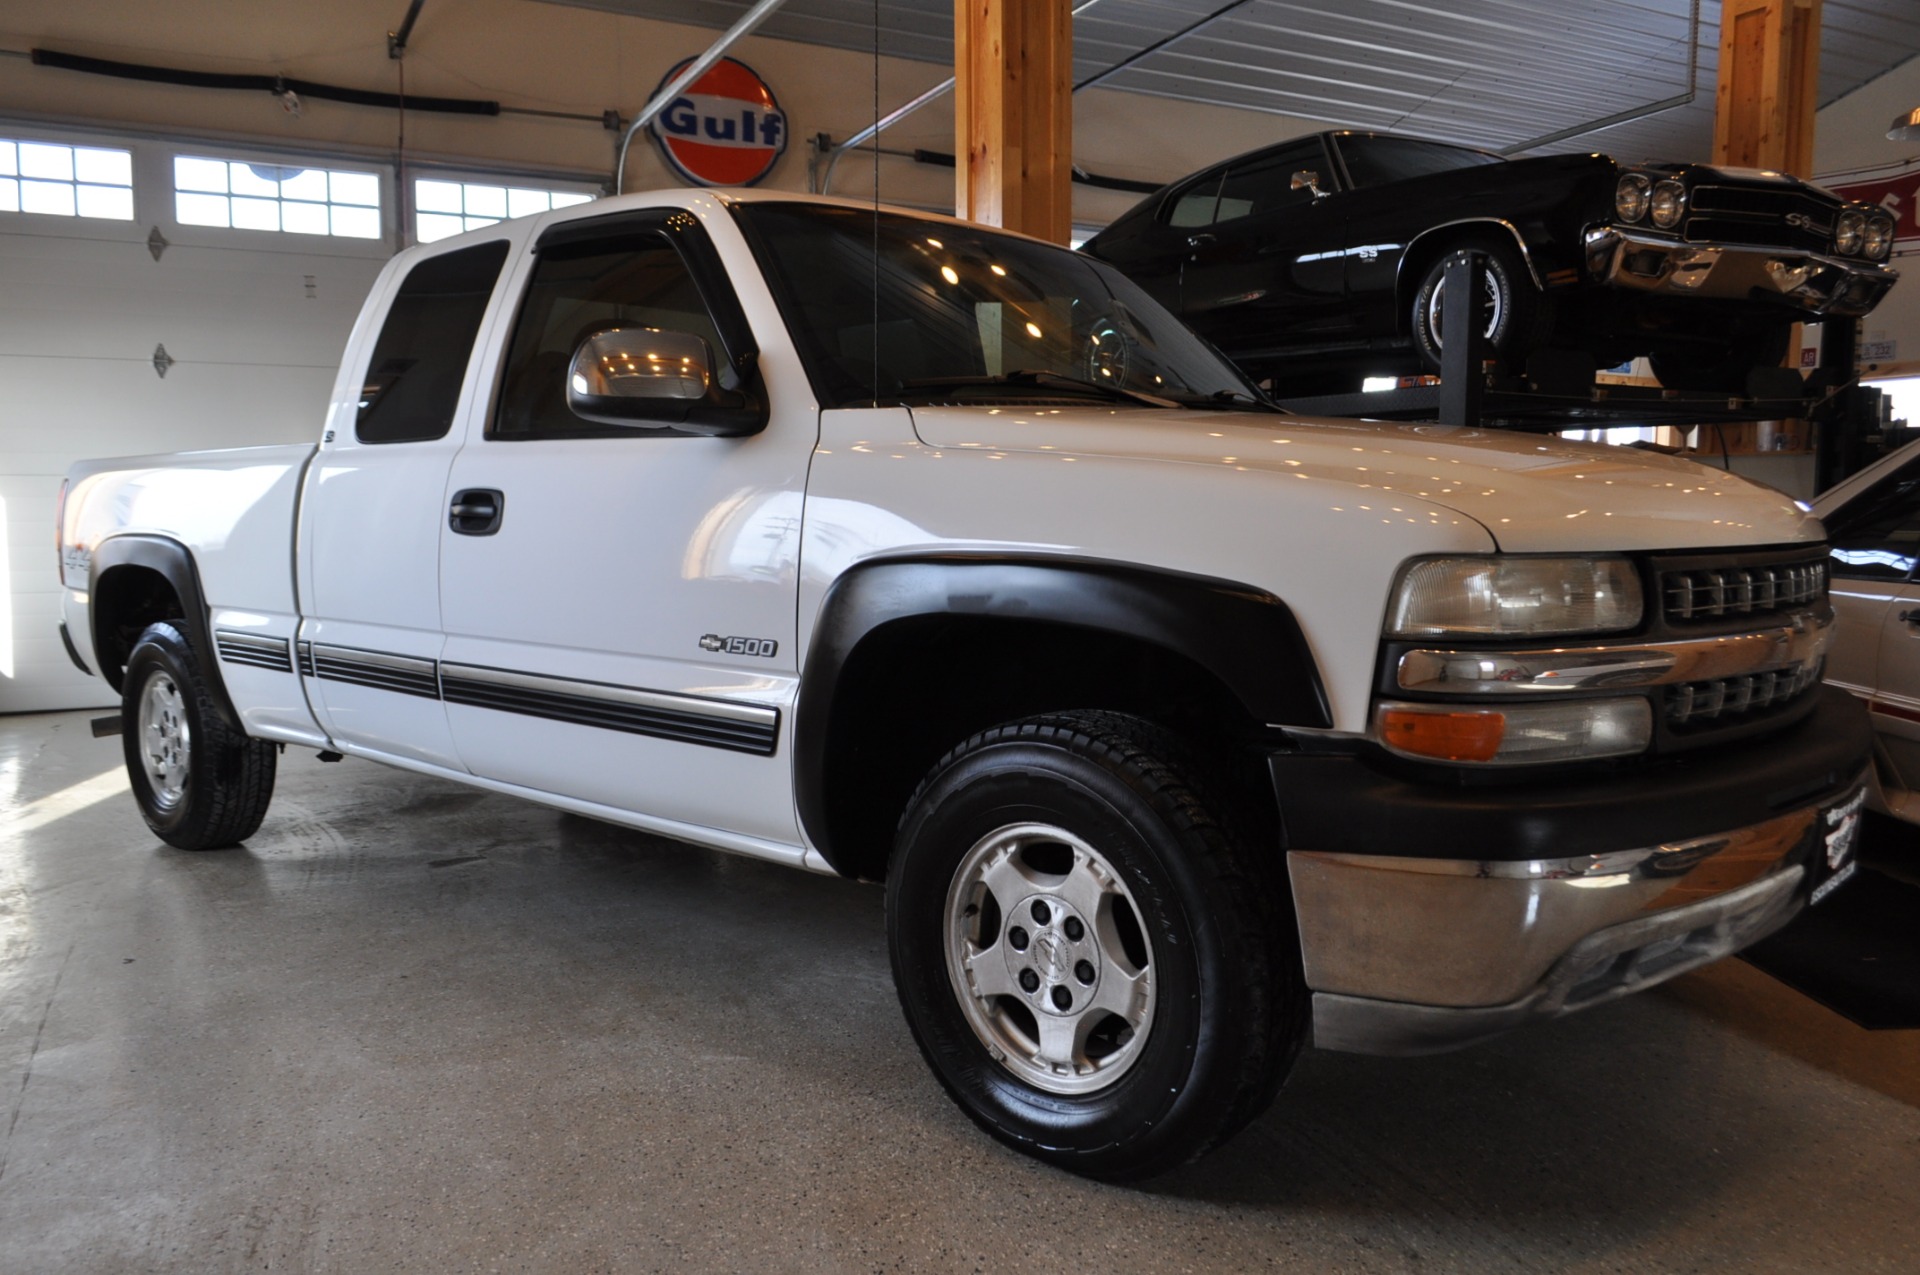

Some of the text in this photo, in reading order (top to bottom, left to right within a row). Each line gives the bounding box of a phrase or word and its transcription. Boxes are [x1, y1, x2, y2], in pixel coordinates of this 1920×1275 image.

[659, 97, 782, 146] Gulf
[1785, 213, 1809, 228] SS
[1359, 245, 1378, 258] SS
[726, 638, 774, 657] 1500
